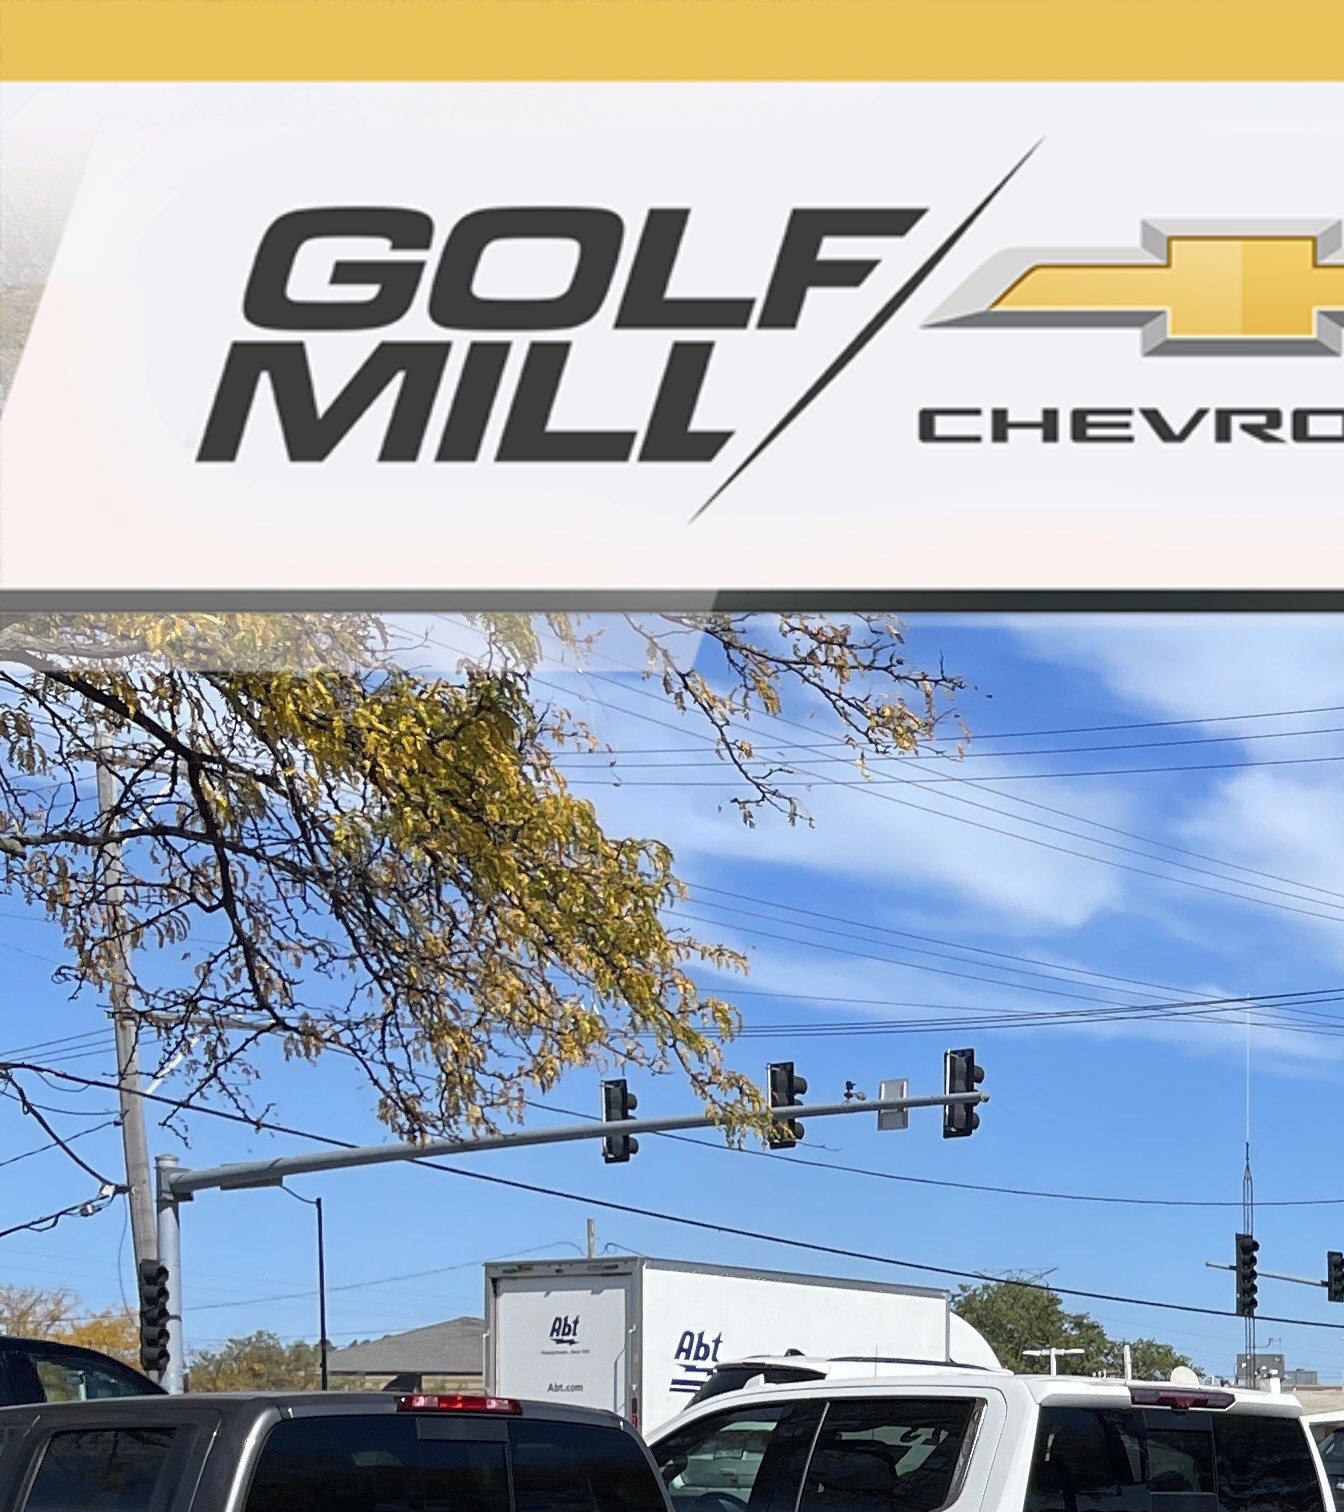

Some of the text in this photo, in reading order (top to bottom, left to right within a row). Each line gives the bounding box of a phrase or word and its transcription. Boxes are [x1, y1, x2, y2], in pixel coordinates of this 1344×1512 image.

[549, 1315, 580, 1337] Abt
[674, 1330, 724, 1362] Abt
[547, 1382, 584, 1392] Abt.com
